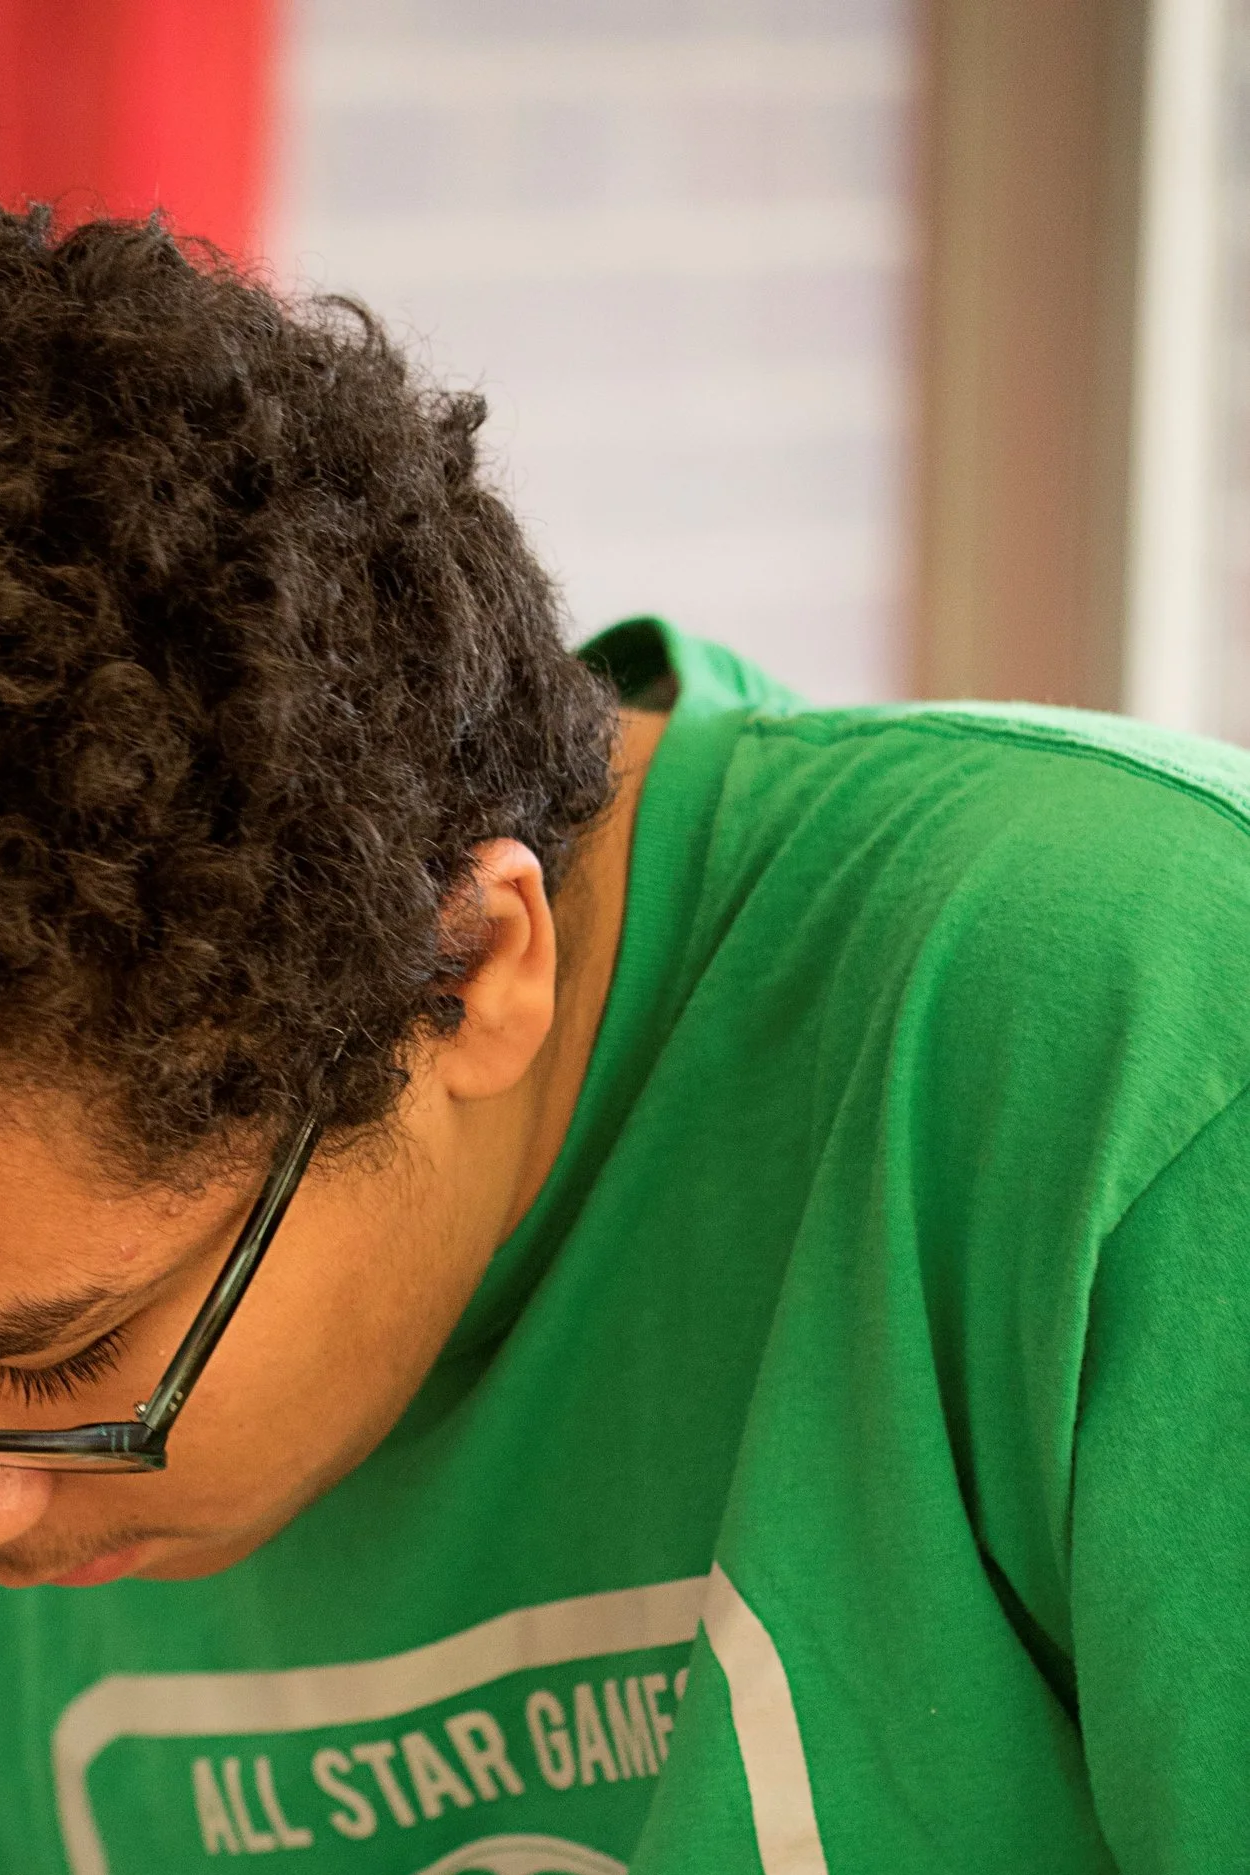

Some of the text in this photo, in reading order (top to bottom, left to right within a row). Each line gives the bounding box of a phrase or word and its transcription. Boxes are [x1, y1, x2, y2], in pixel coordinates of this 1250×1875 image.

[192, 1668, 686, 1856] ALL STAR GAME
